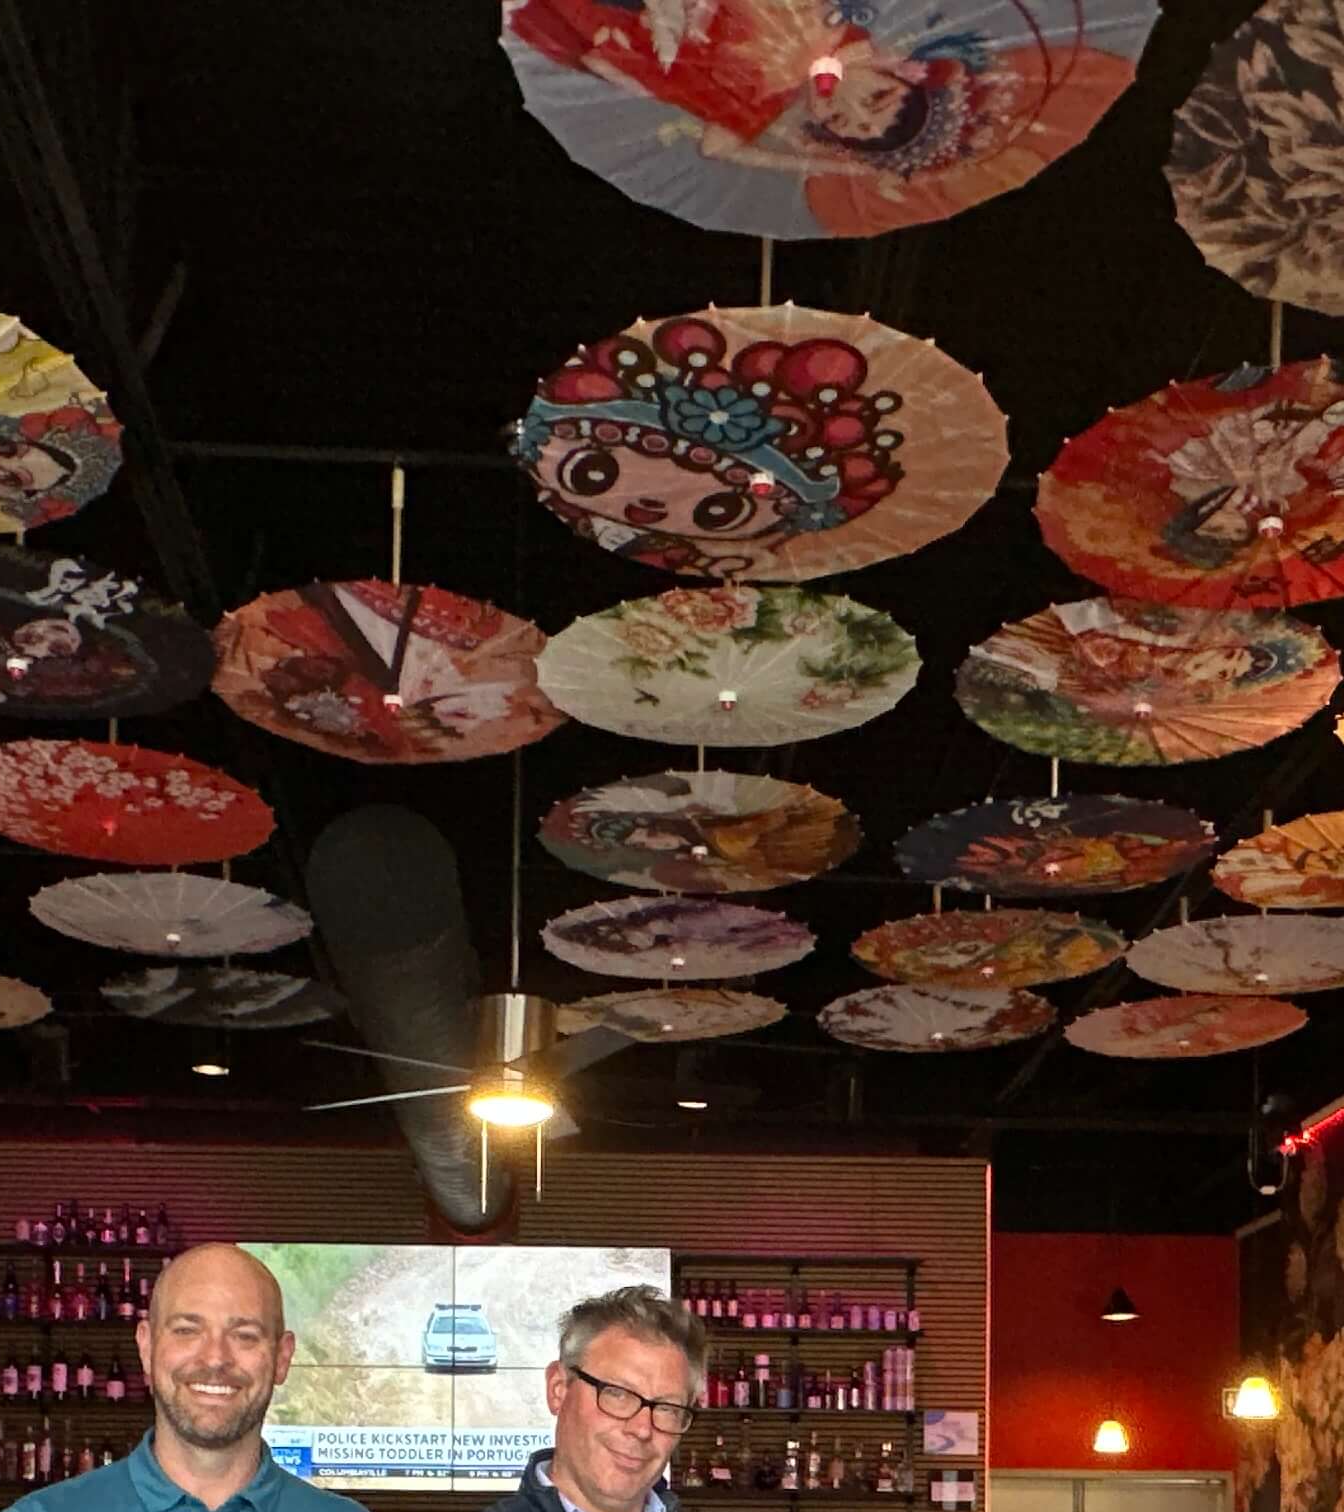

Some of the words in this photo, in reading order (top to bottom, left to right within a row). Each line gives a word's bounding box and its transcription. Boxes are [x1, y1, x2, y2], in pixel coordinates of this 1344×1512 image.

[318, 1432, 366, 1445] POLICE
[371, 1432, 447, 1446] KICKSTART
[452, 1434, 485, 1446] NEW
[318, 1447, 374, 1460] MISSING
[379, 1448, 443, 1460] TODDLER
[447, 1449, 463, 1460] IN
